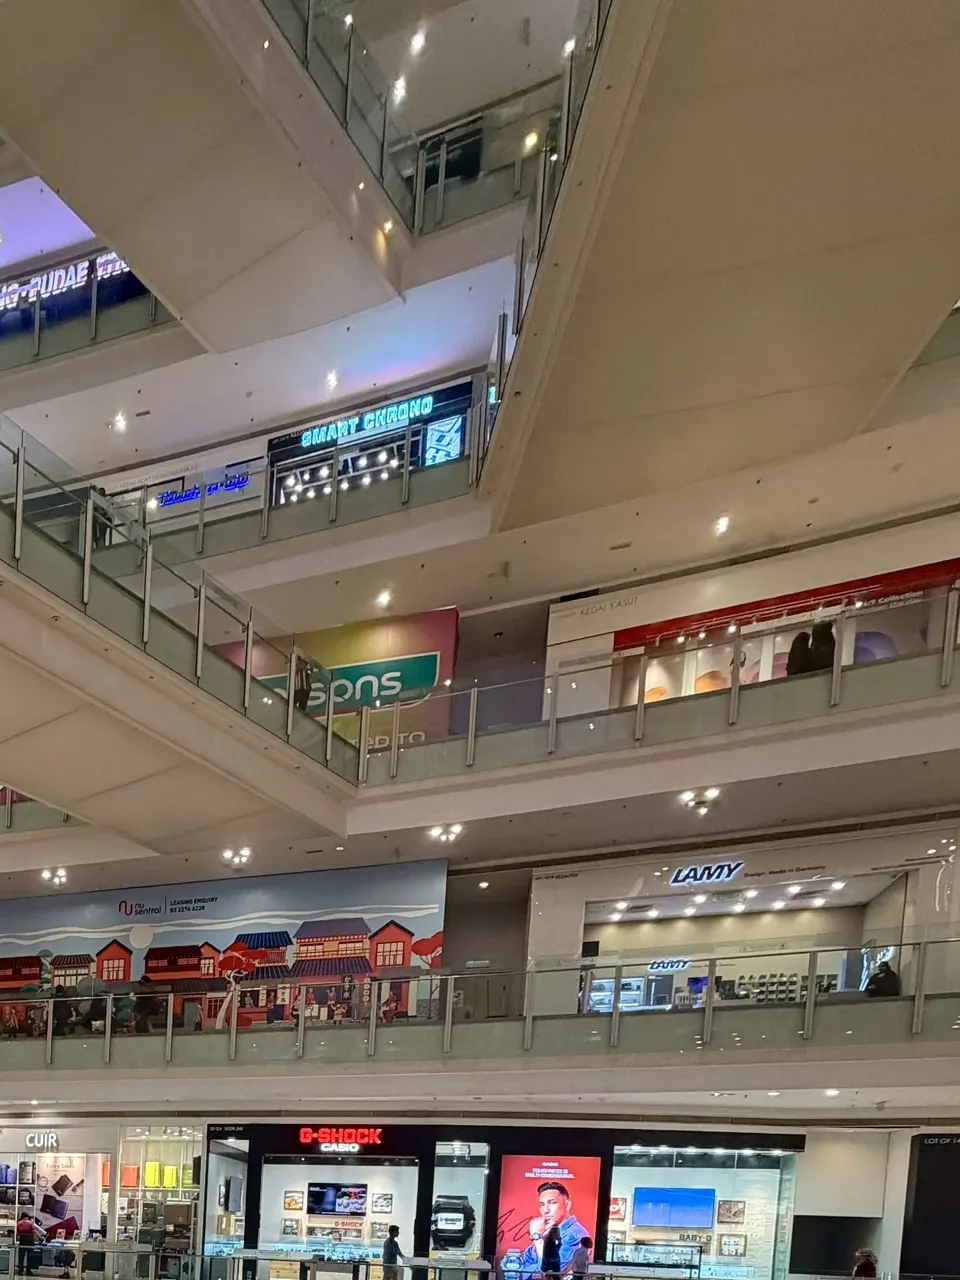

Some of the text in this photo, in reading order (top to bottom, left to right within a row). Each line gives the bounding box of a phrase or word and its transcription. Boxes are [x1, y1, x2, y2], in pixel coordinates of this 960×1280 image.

[301, 396, 434, 448] SMART CHRONO
[670, 861, 745, 886] LAMY
[648, 958, 692, 972] LAMY
[300, 1127, 382, 1144] G-SHOCK
[320, 1143, 360, 1152] CASIO
